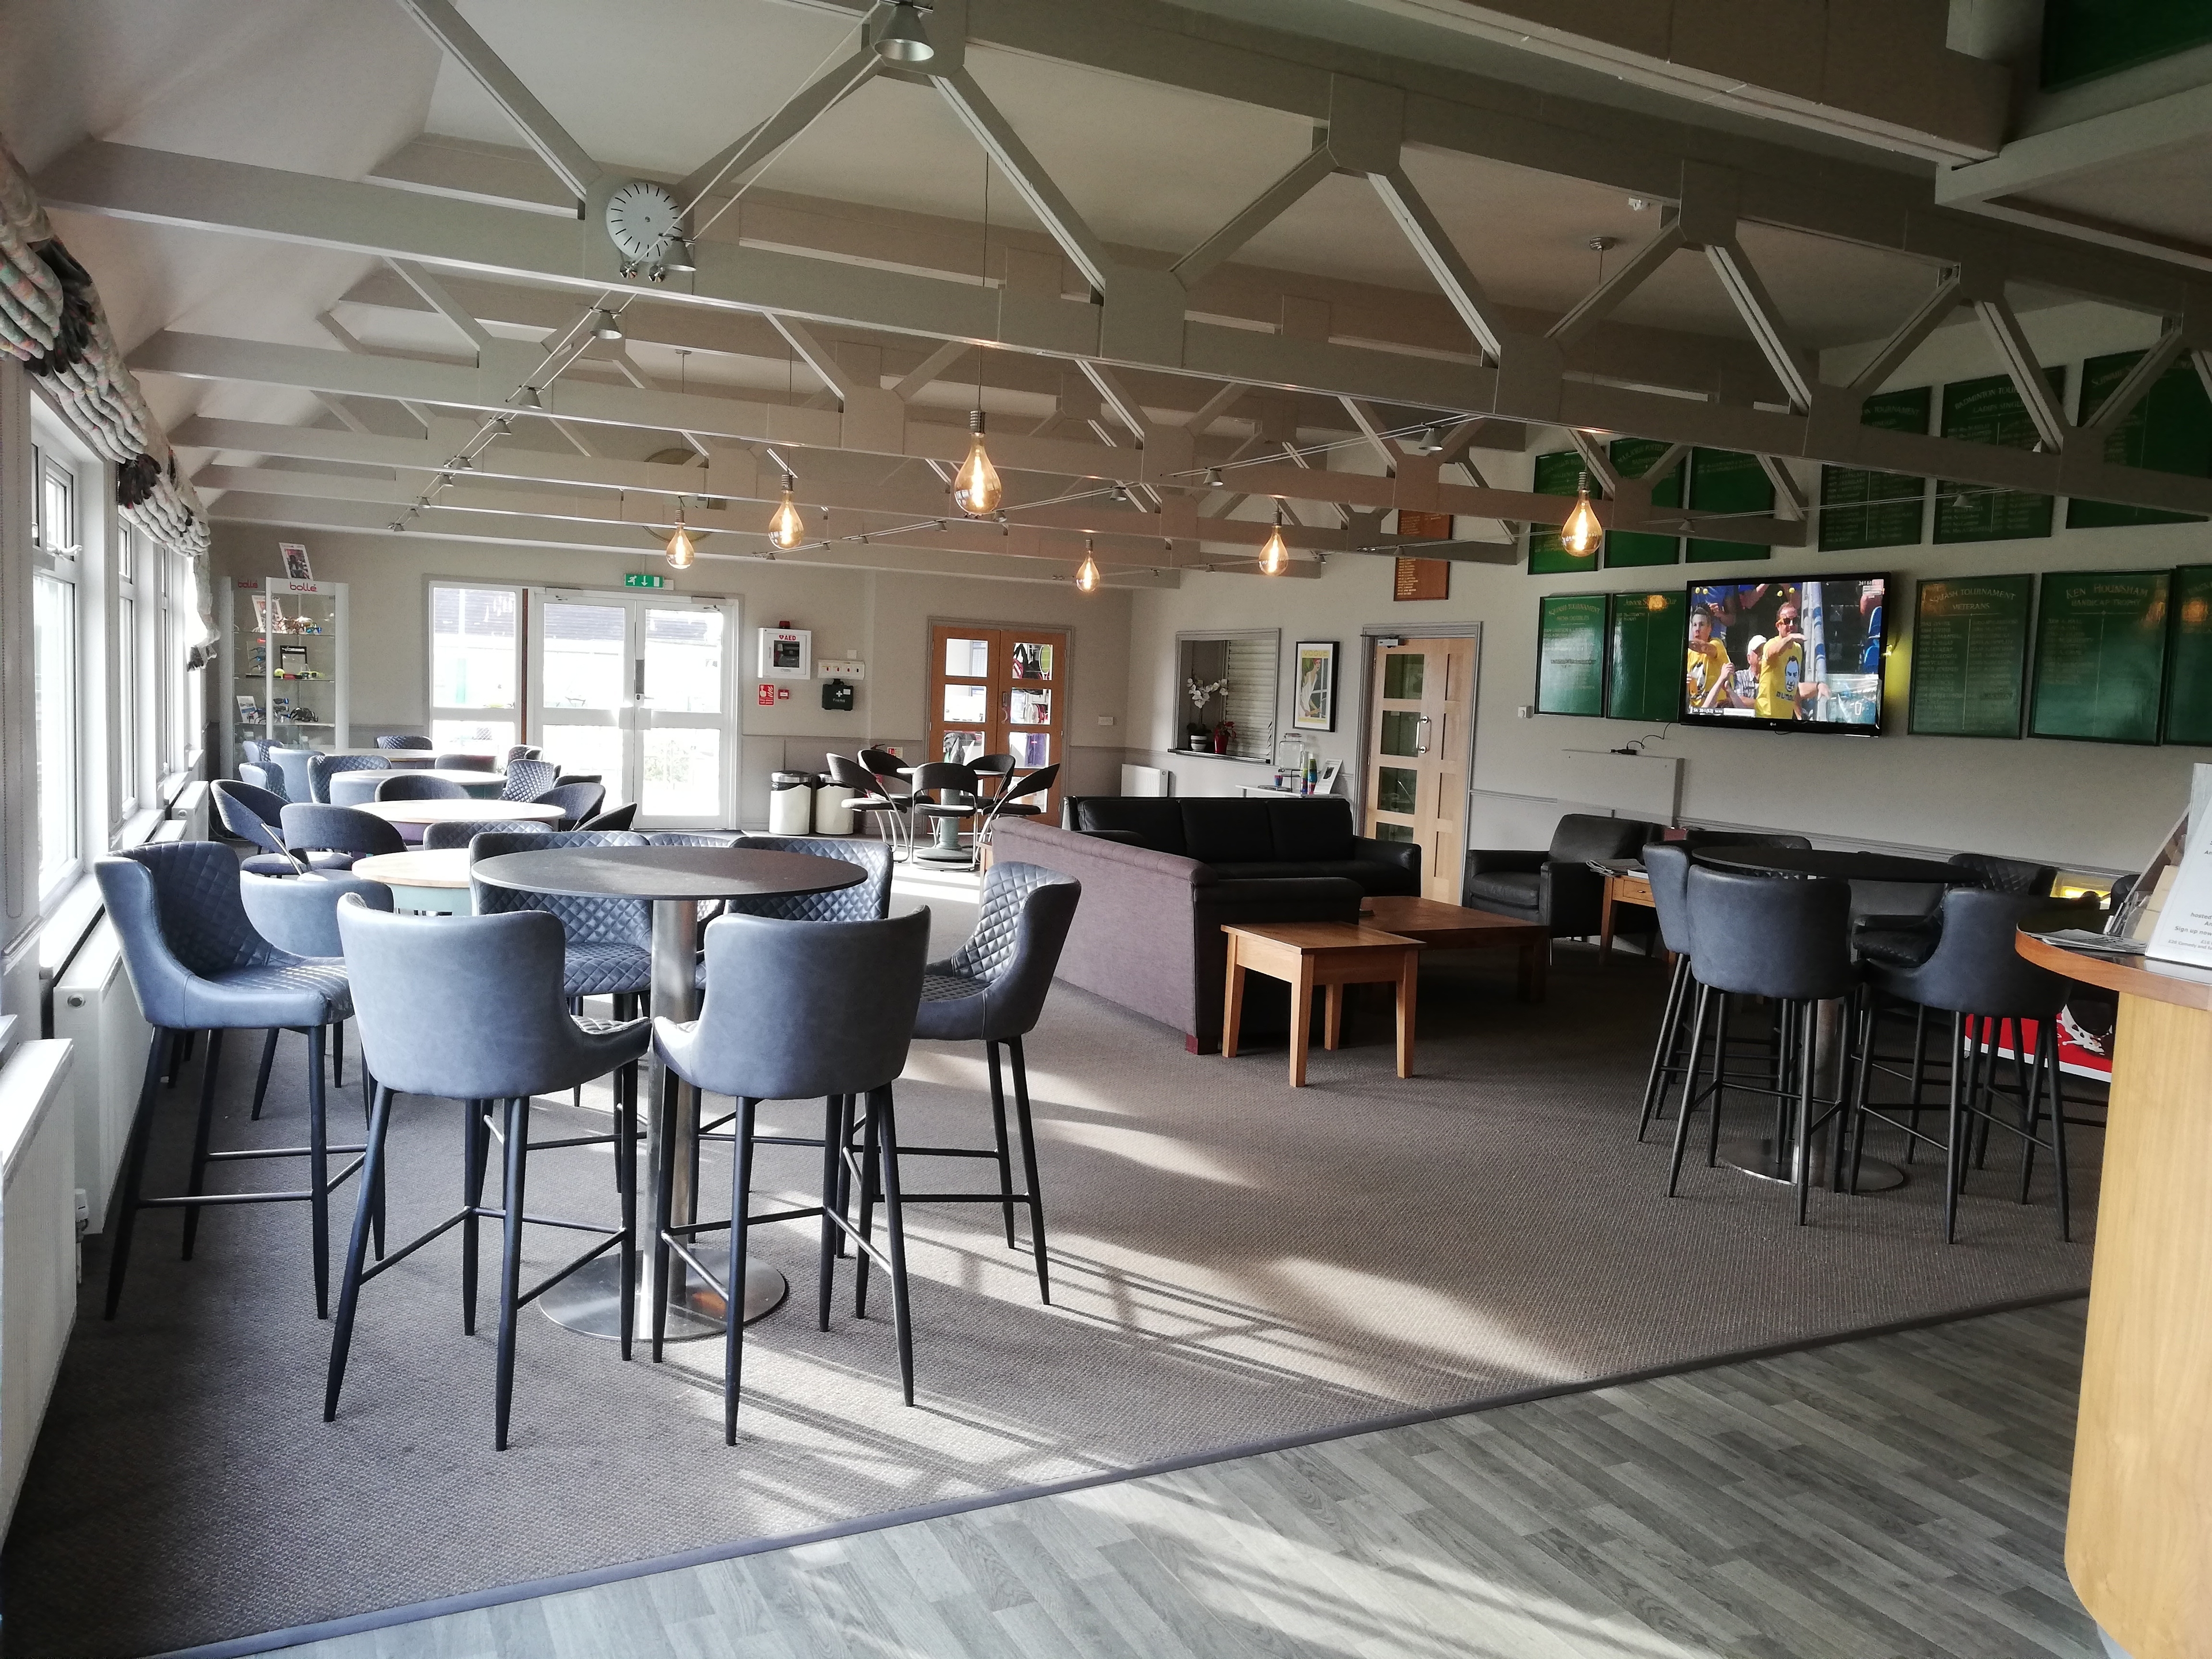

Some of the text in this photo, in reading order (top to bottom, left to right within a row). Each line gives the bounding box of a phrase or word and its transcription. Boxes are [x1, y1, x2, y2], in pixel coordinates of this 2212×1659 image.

[1955, 388, 1996, 410] BADMINTON
[1874, 406, 1920, 416] TOURNAMENT
[1973, 403, 1998, 414] LADIES
[290, 581, 317, 592] bollé
[1961, 588, 2016, 600] TOURNAMENT
[2066, 588, 2086, 599] KEN
[1952, 603, 1990, 611] VETERANS
[2071, 598, 2110, 606] HANDICAP
[1568, 603, 1601, 614] TOURNAMENT
[2178, 941, 2197, 949] Comedy
